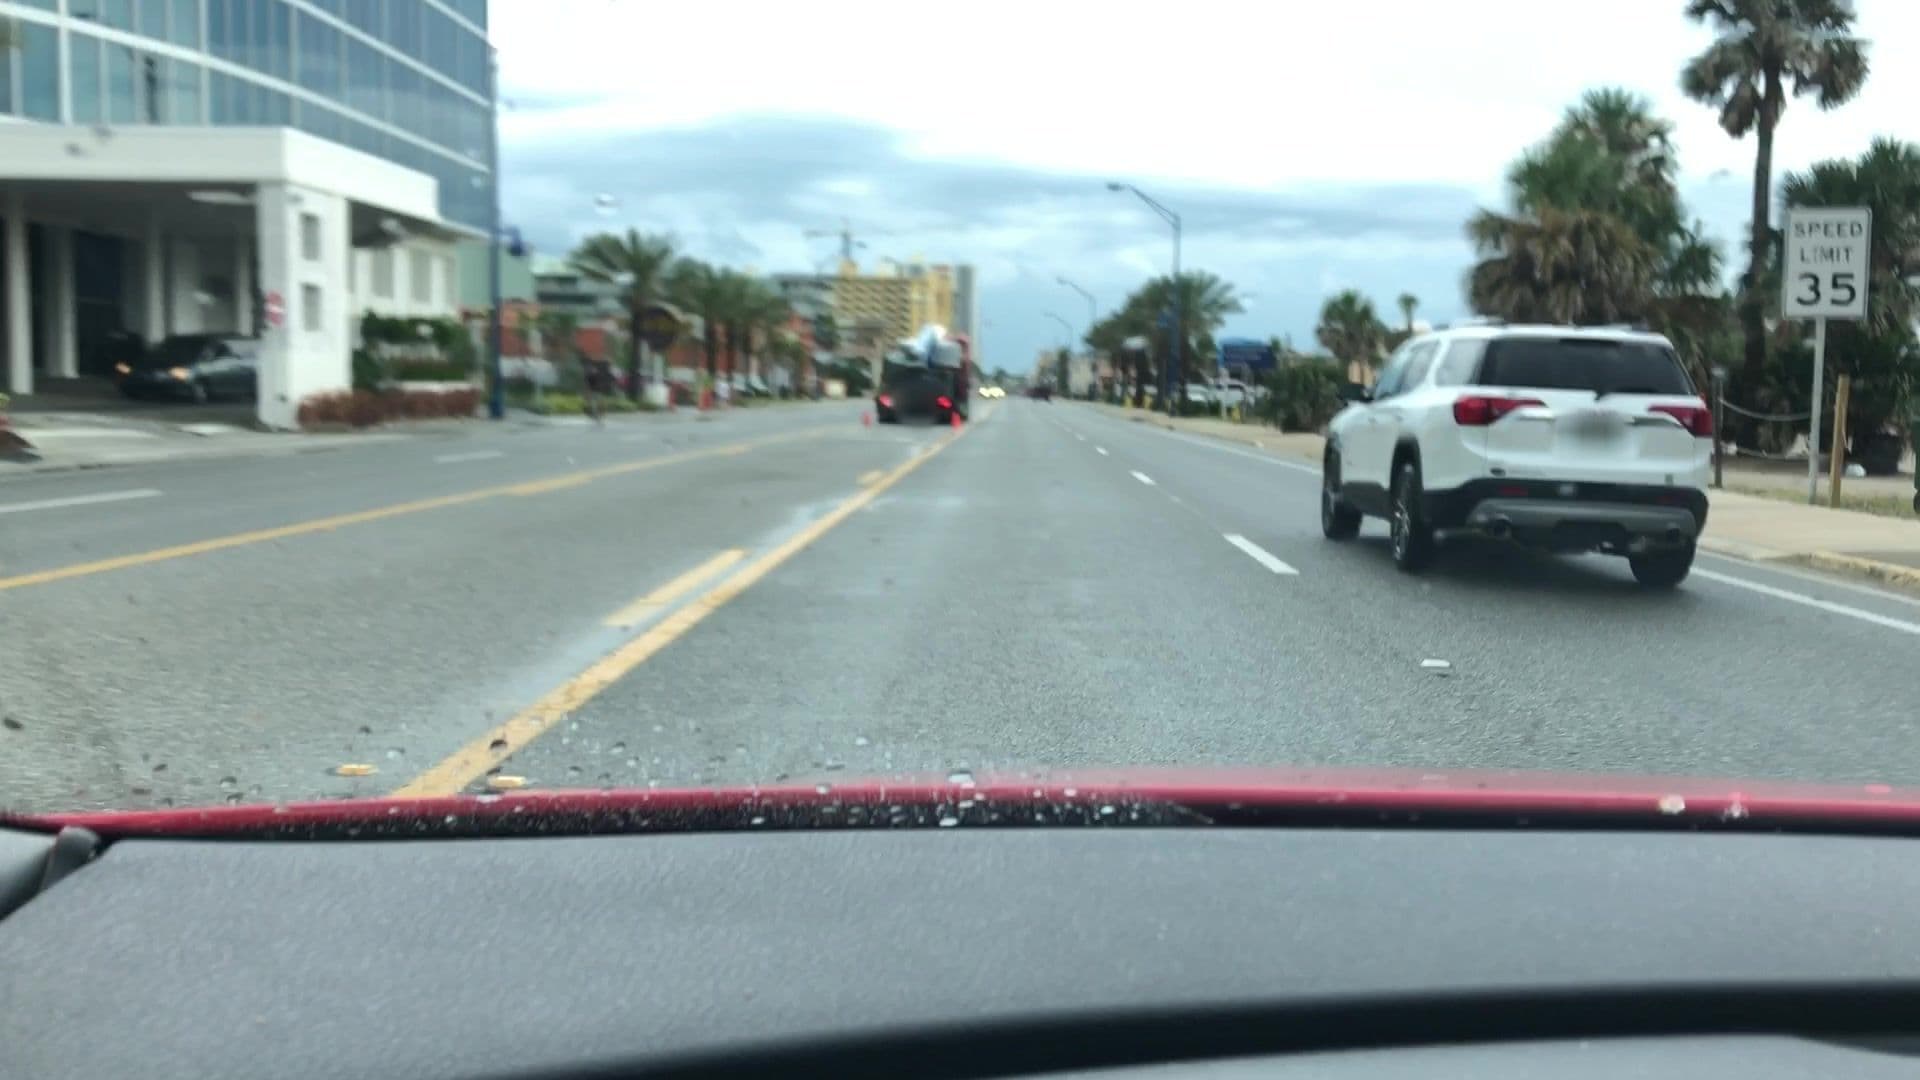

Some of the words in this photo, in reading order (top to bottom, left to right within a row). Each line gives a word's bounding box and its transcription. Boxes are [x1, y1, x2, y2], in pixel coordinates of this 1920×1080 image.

[1795, 223, 1863, 238] SPEED
[1800, 247, 1852, 264] LIMIT
[1796, 272, 1857, 307] 35
